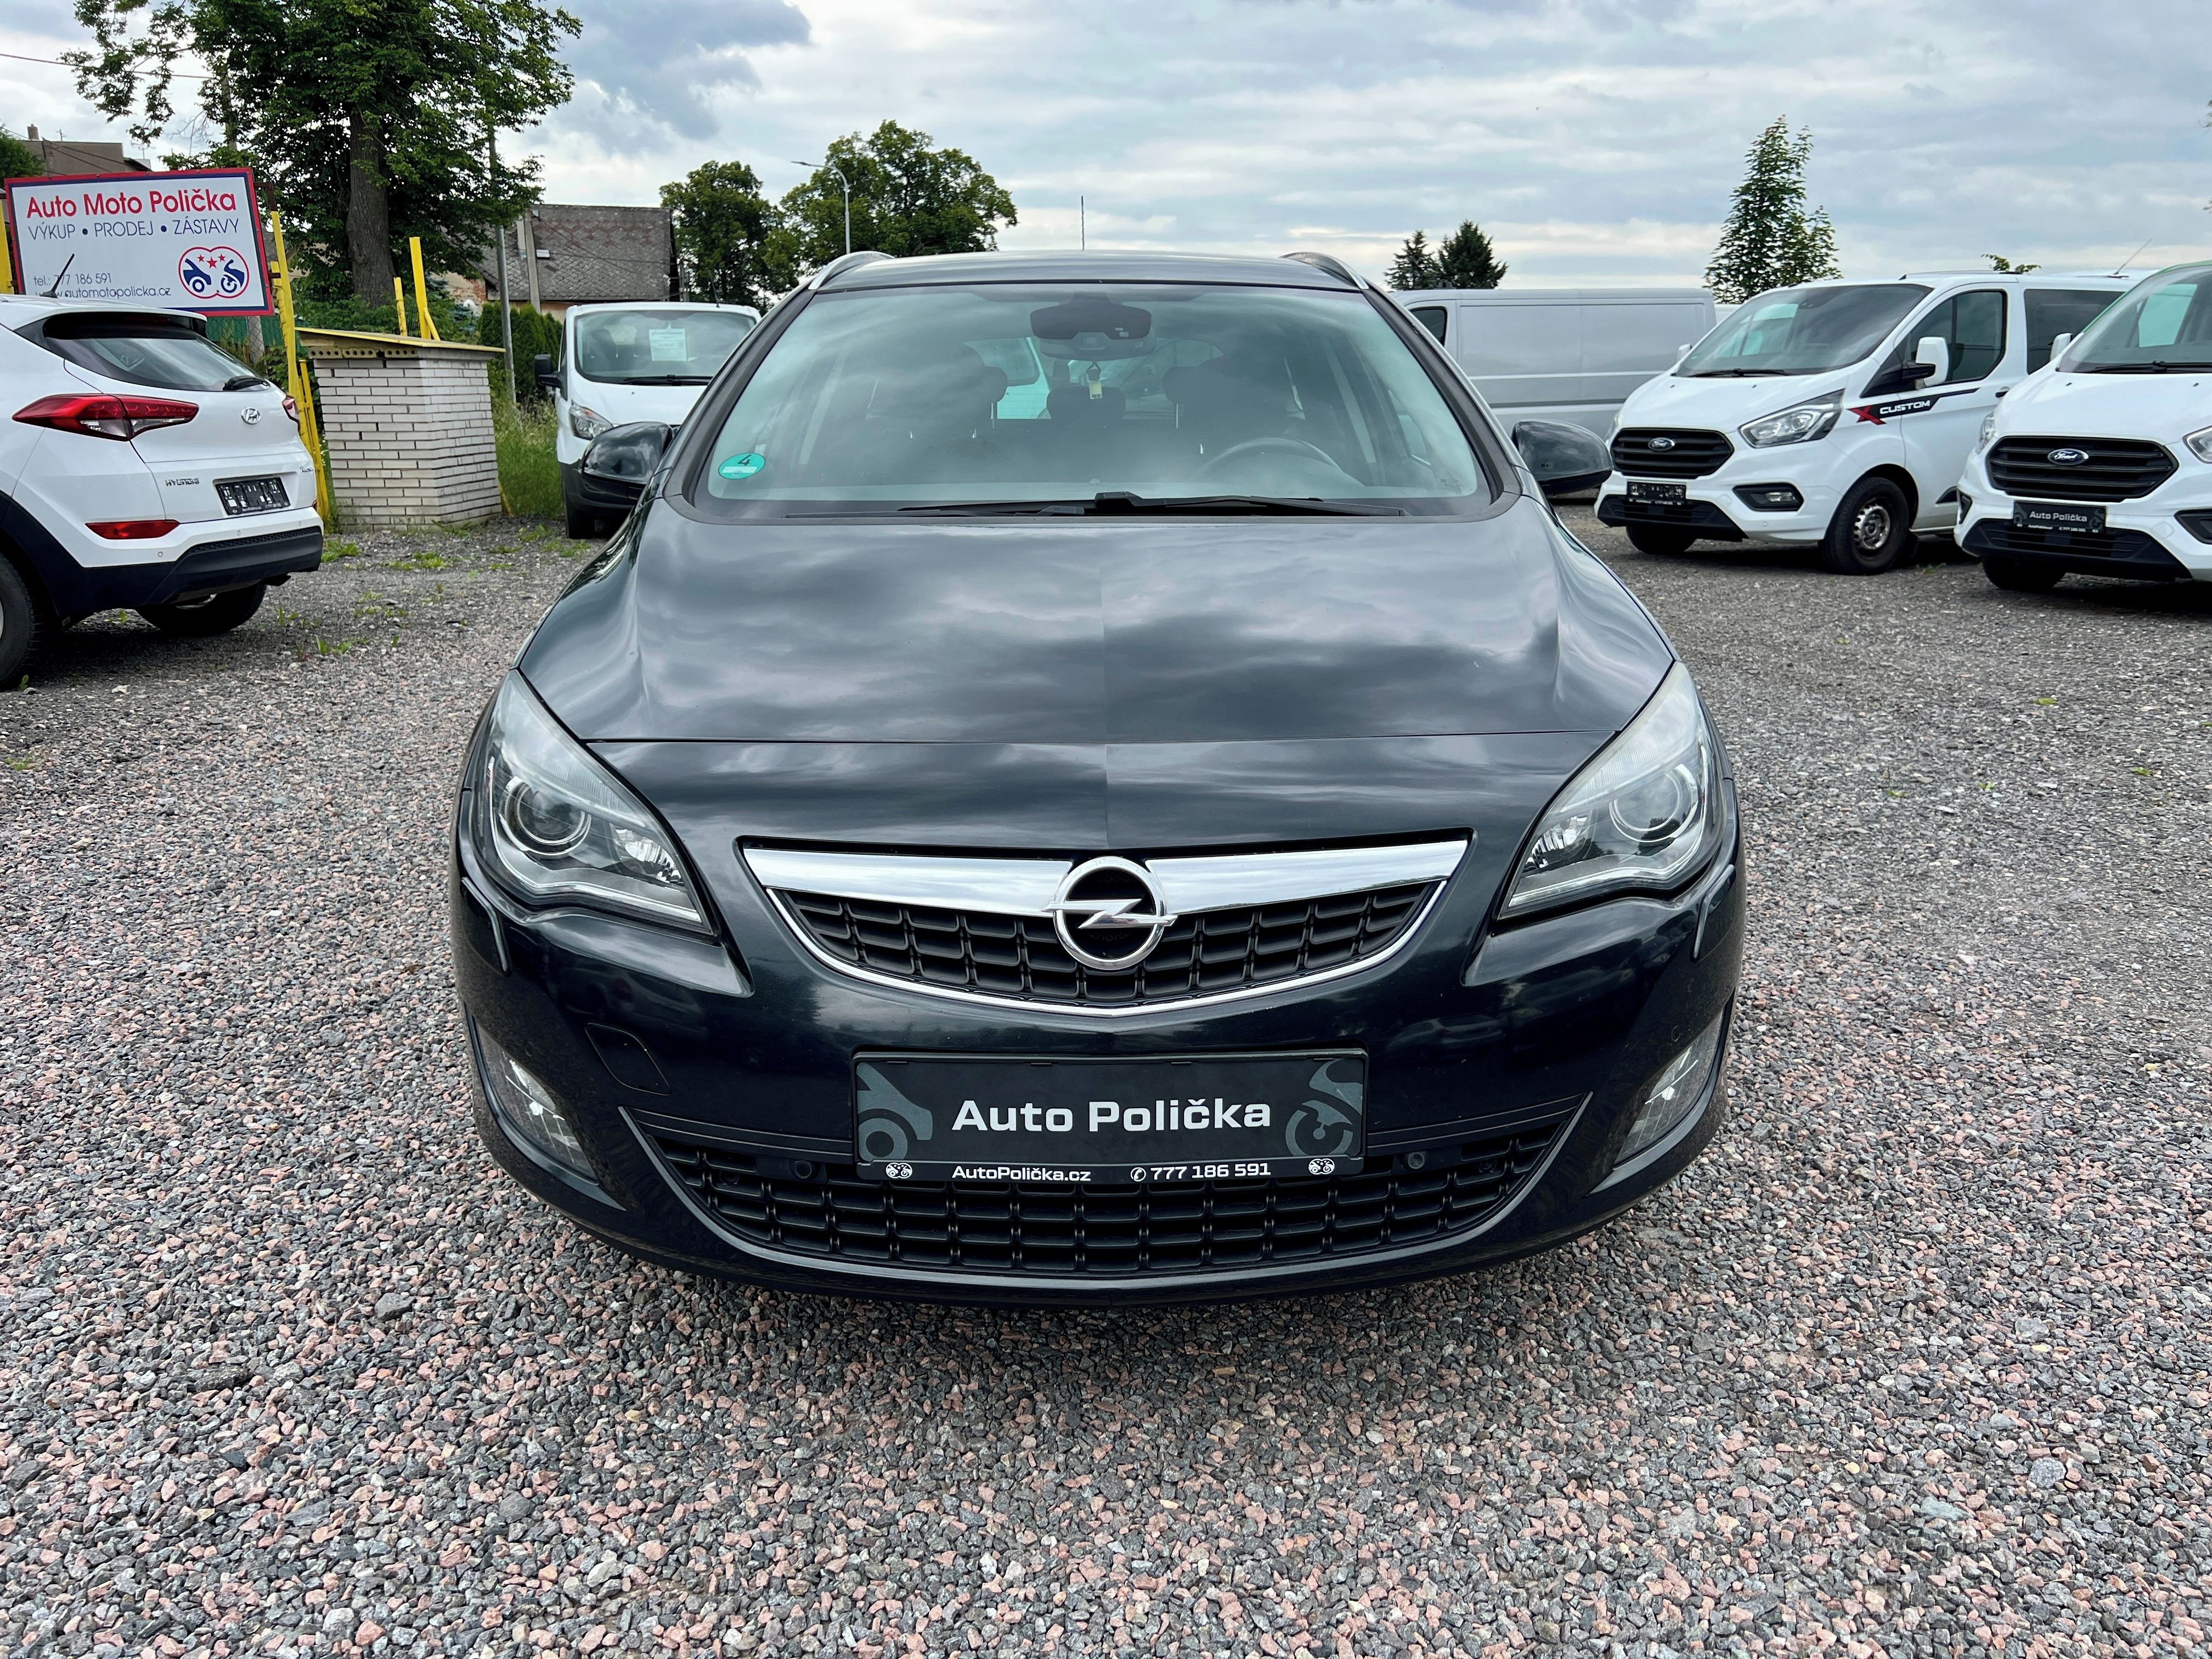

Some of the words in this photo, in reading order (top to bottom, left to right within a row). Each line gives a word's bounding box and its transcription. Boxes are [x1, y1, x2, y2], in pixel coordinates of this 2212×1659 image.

[27, 195, 77, 218] Auto
[83, 192, 143, 215] Moto
[149, 189, 237, 213] Polička
[28, 222, 76, 240] VÝKUP
[94, 221, 154, 238] PRODEJ
[173, 216, 239, 234] ZÁSTAVY
[33, 275, 51, 286] tel.:
[75, 273, 93, 284] 186
[95, 273, 111, 284] 591
[35, 286, 171, 299] w.automotopolicka.cz
[1880, 400, 1931, 415] CUSTOM
[737, 454, 752, 466] 4
[2029, 511, 2051, 520] Auto
[2053, 512, 2087, 522] Polička
[952, 1101, 1073, 1132] Auto
[1089, 1098, 1270, 1132] Polička
[951, 1166, 1091, 1181] AutoPolička.cz
[1150, 1167, 1187, 1180] 777
[1192, 1165, 1229, 1178] 186
[1234, 1163, 1271, 1177] 591
